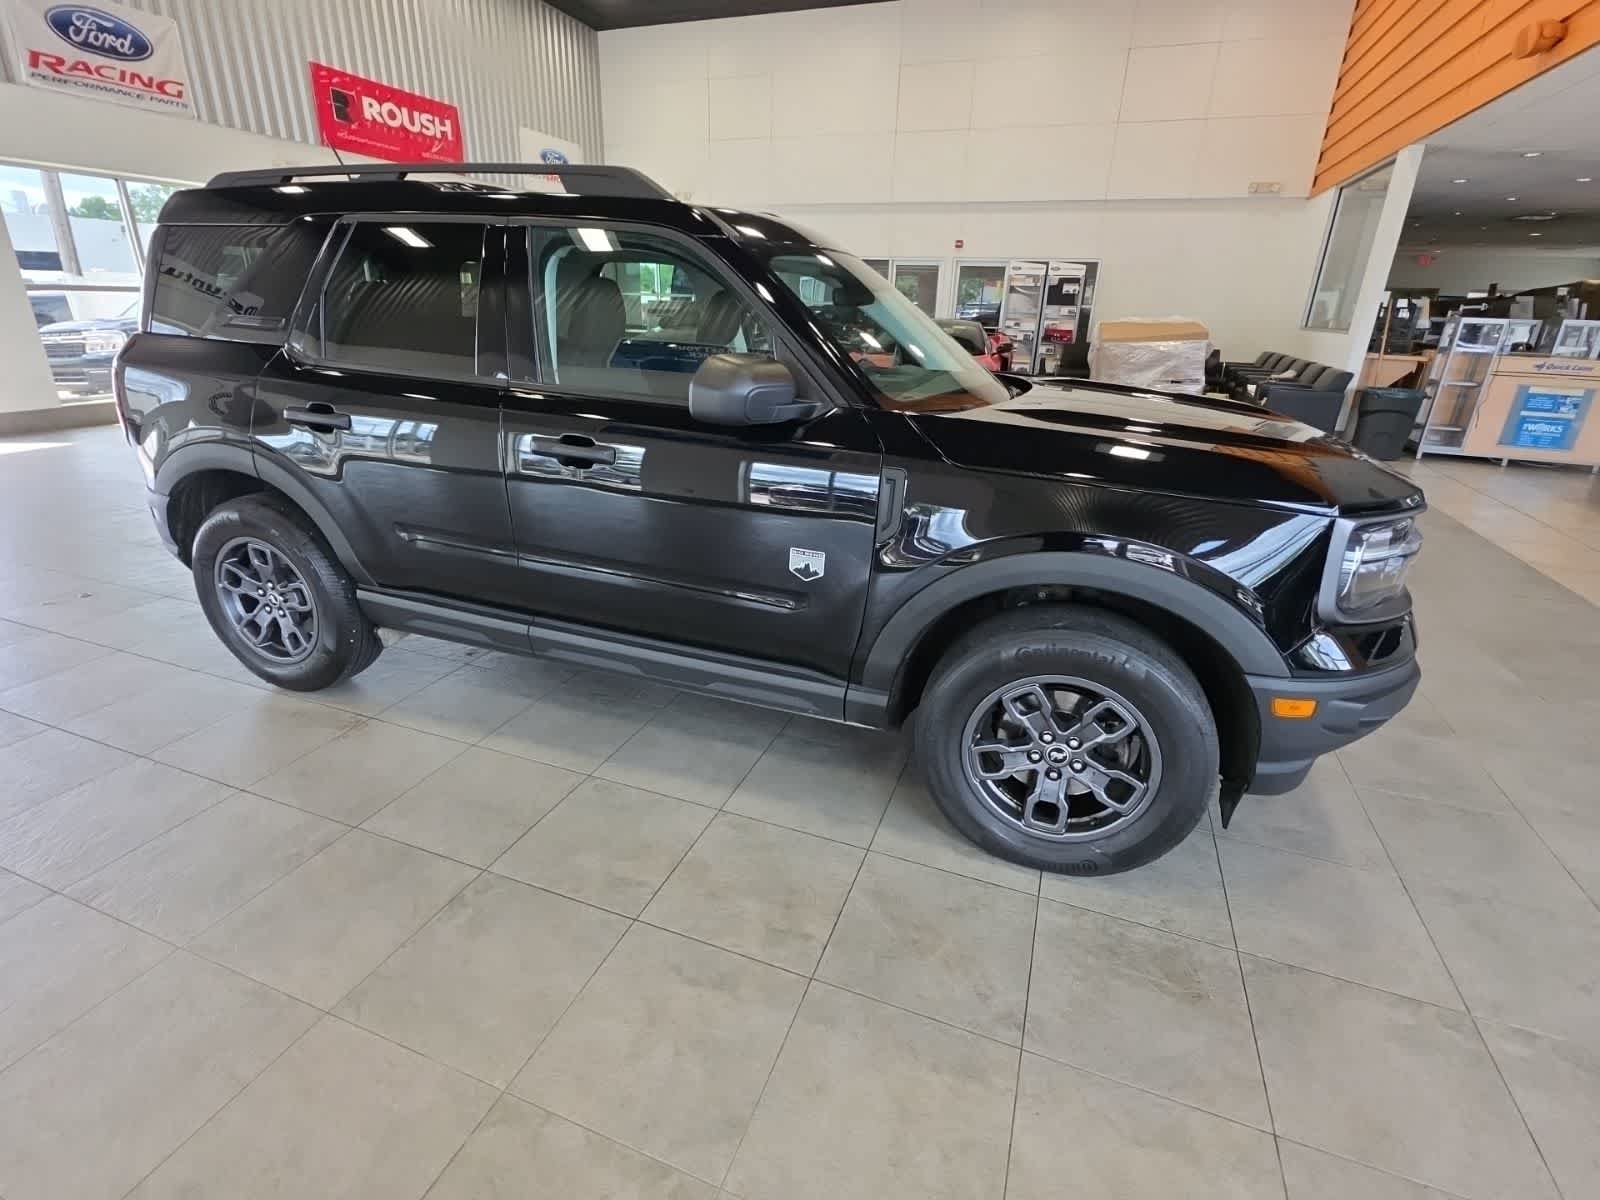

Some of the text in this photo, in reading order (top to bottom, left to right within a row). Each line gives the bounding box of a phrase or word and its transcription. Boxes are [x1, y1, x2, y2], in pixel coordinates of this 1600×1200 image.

[69, 12, 134, 54] Ford
[28, 50, 184, 99] RACING
[30, 71, 145, 100] PERFORMANCE
[361, 95, 455, 141] ROUSH
